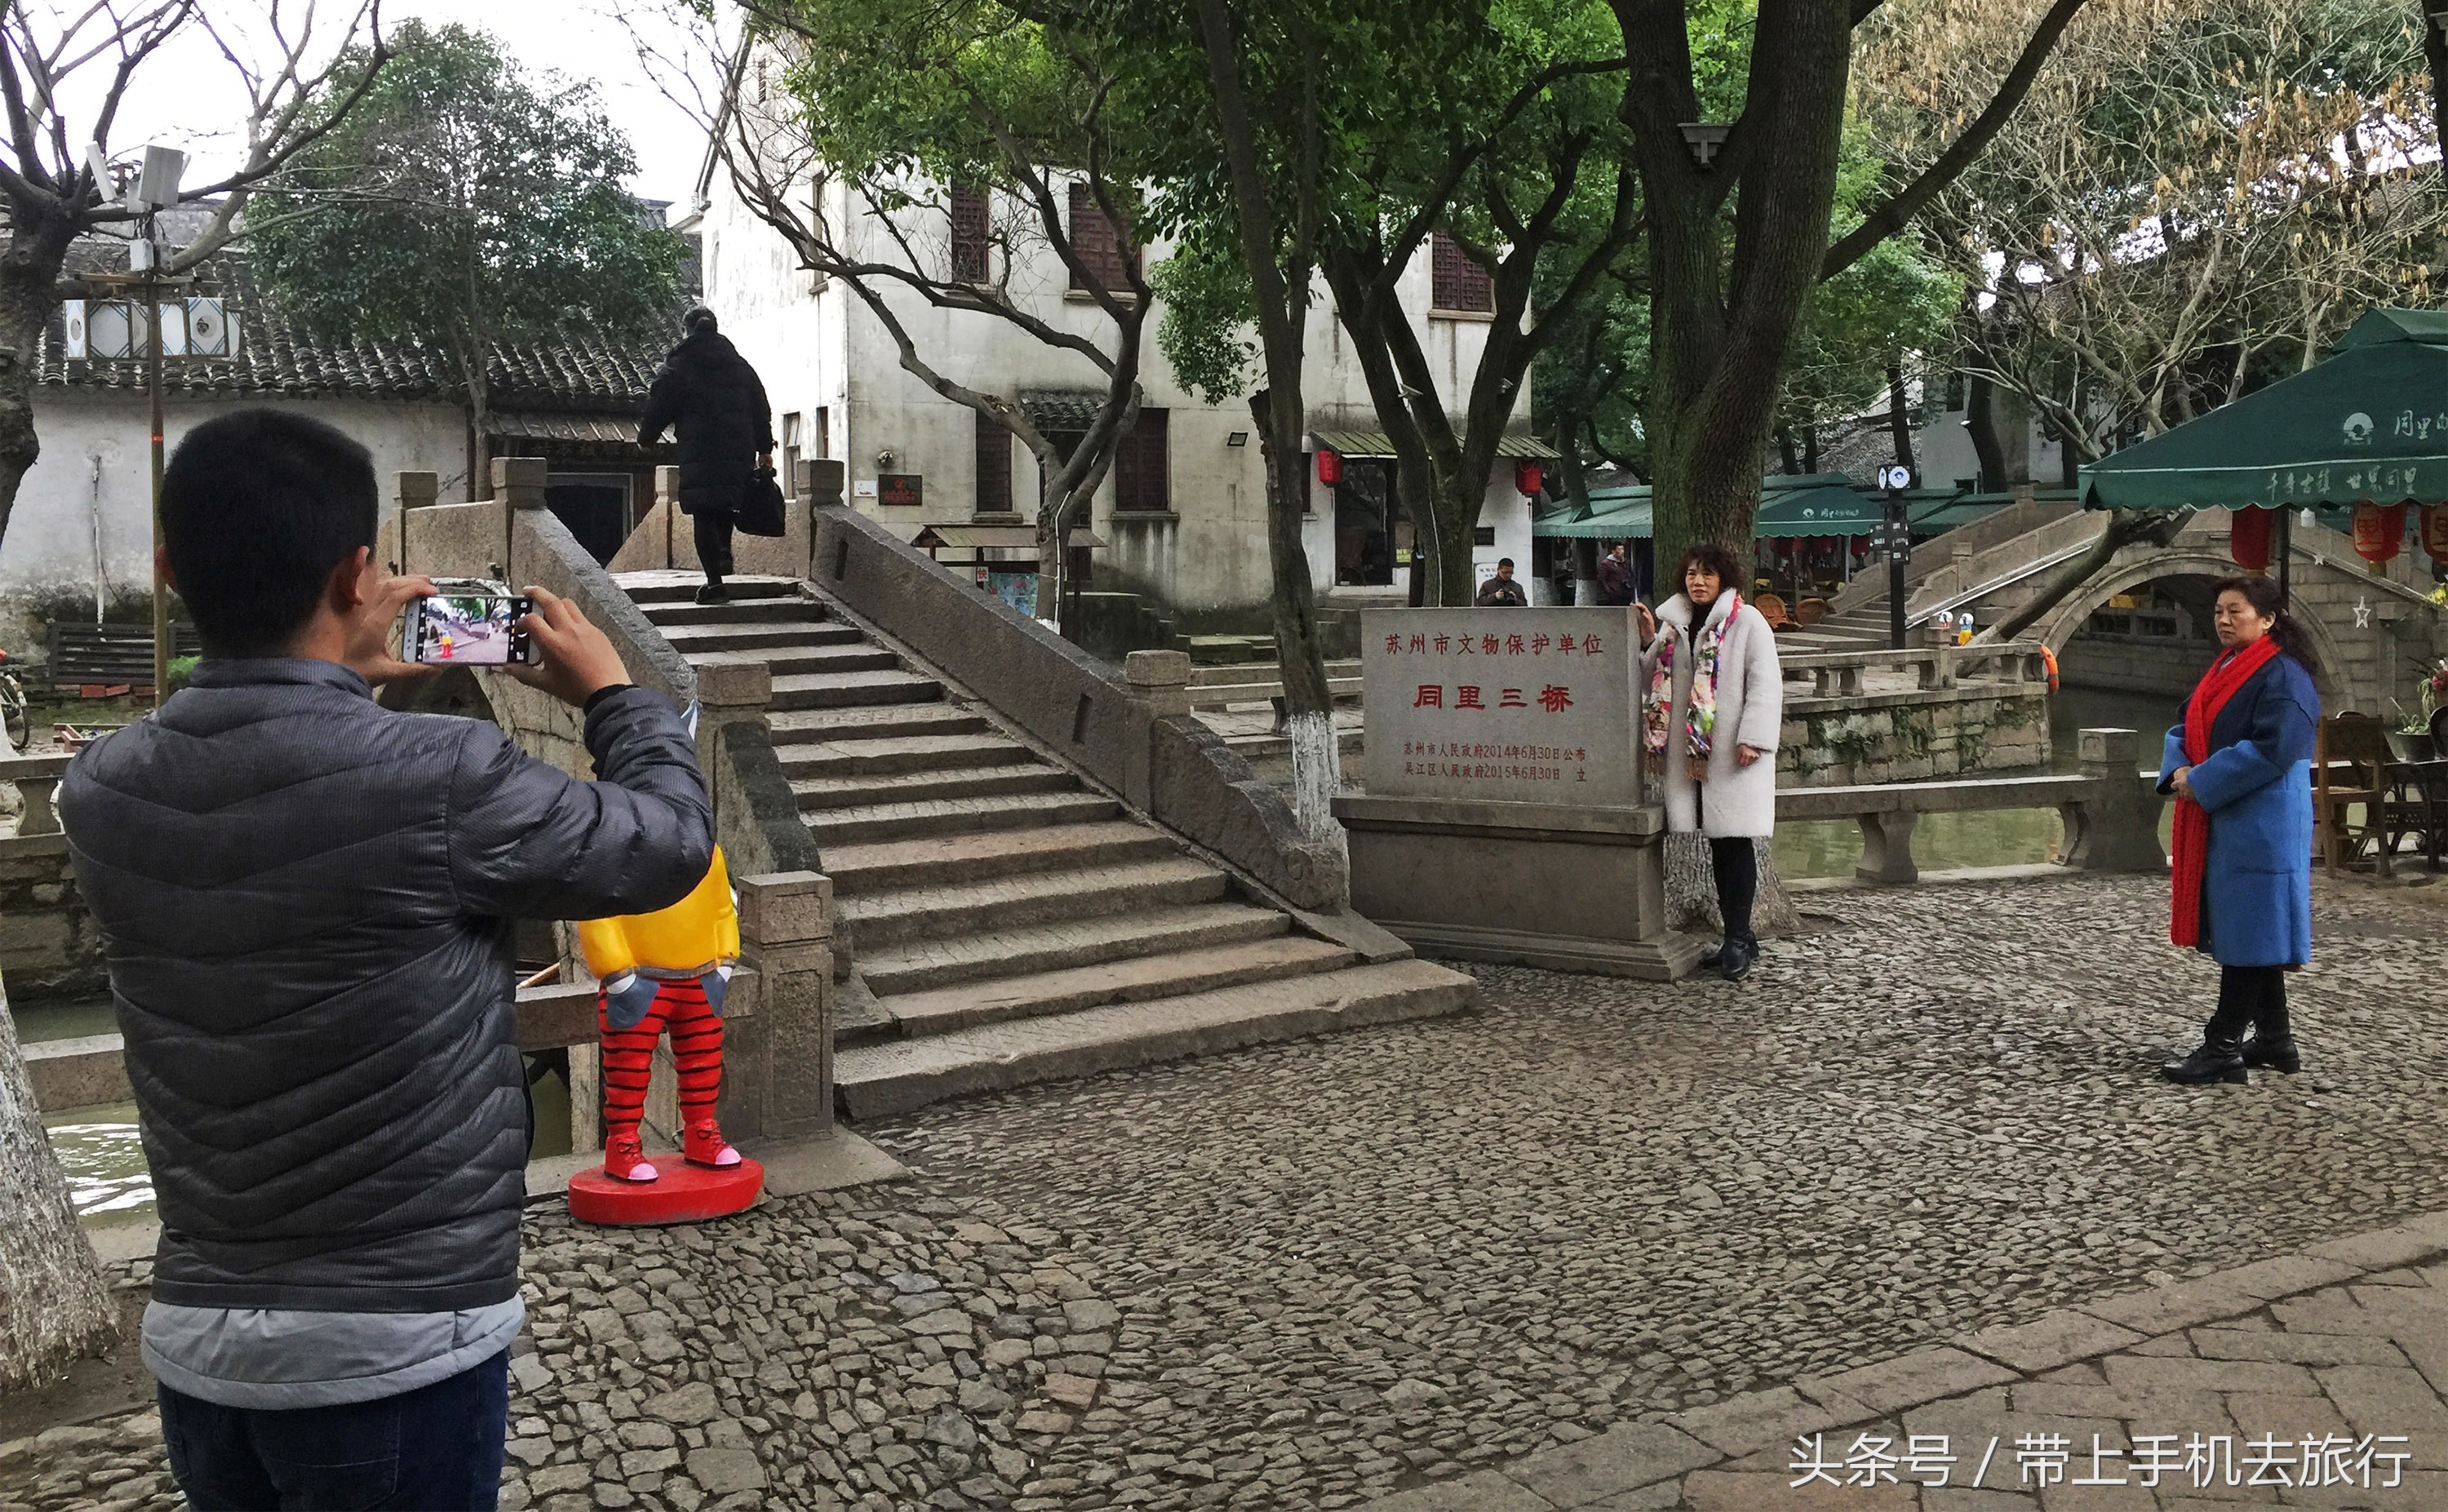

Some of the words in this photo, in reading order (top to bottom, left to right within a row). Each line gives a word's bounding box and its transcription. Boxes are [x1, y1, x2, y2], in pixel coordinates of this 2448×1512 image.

[1386, 632, 1604, 657] 苏州市文物保护单位
[1412, 684, 1574, 713] 同里三桥
[1404, 741, 1586, 762] 苏州市人民政府2014年6月30日公布
